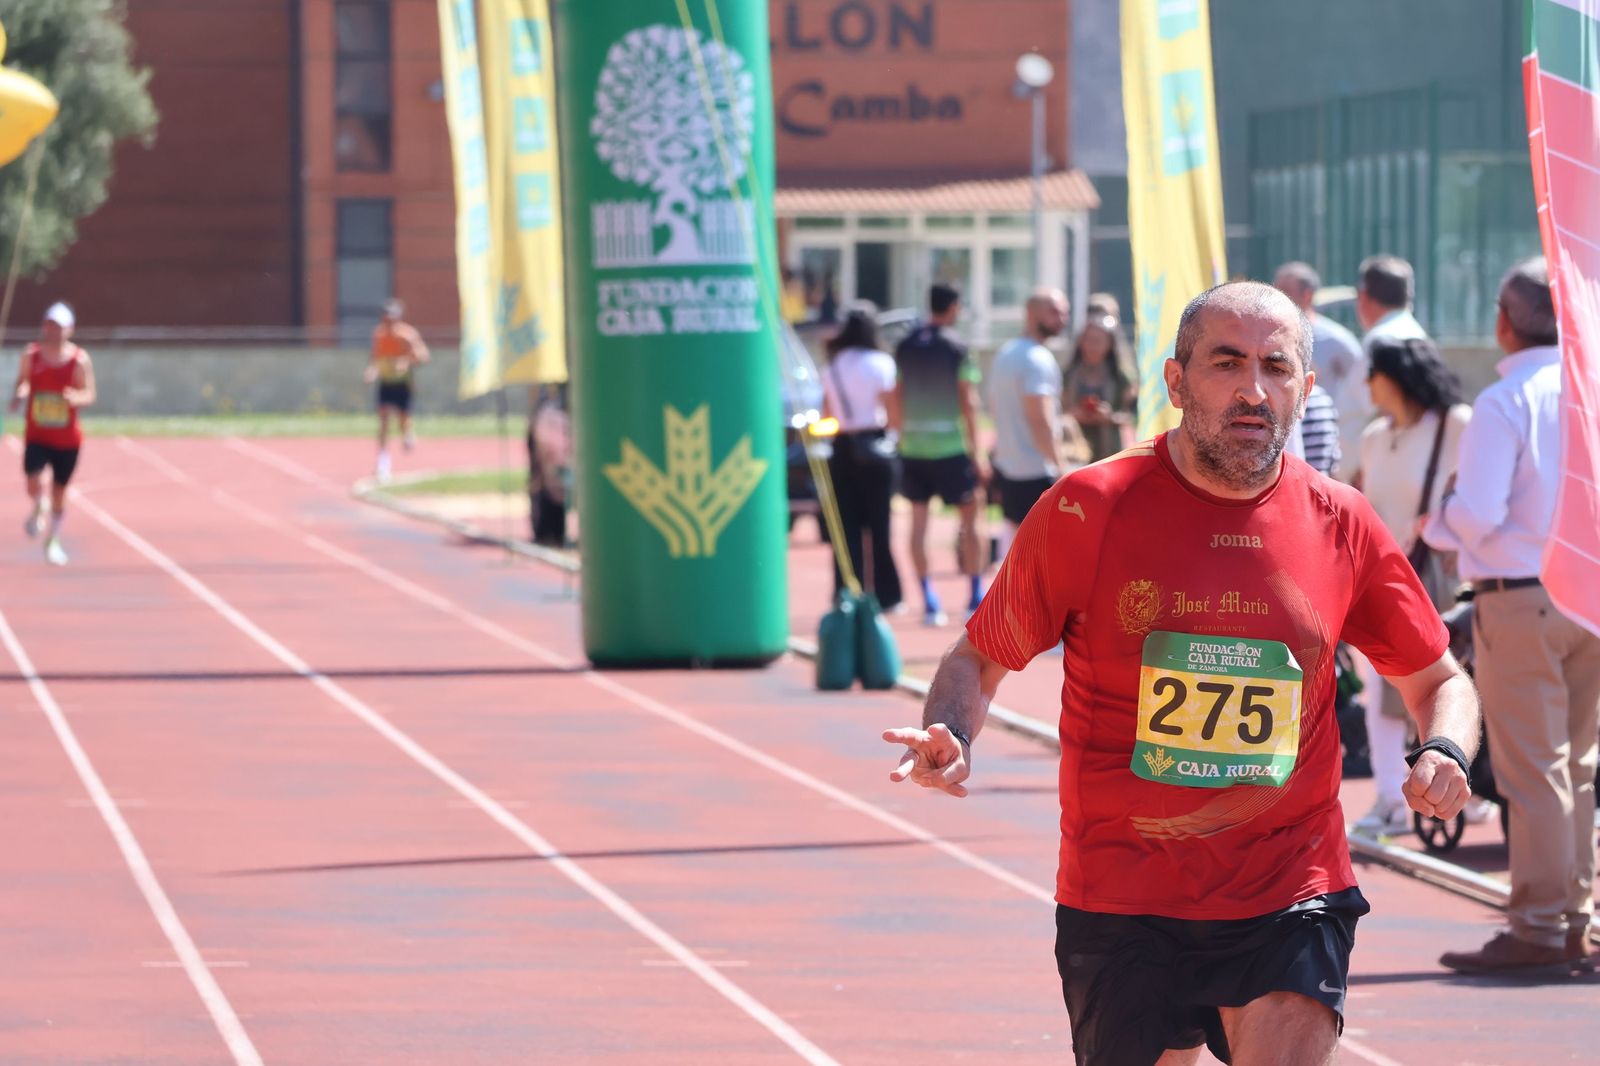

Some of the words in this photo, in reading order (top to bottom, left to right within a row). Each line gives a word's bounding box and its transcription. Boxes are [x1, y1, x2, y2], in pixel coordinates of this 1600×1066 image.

[769, 0, 934, 50] LON
[778, 77, 963, 138] Camba
[1172, 591, 1211, 618] José
[1217, 590, 1270, 620] María
[1193, 624, 1248, 633] RESTAURANTE
[1188, 652, 1218, 665] CAJA
[1220, 655, 1260, 668] RURAL
[1199, 664, 1228, 673] ZAMORA
[1149, 676, 1275, 745] 275
[1177, 760, 1221, 777] CAJA
[1225, 764, 1284, 778] RURAL
